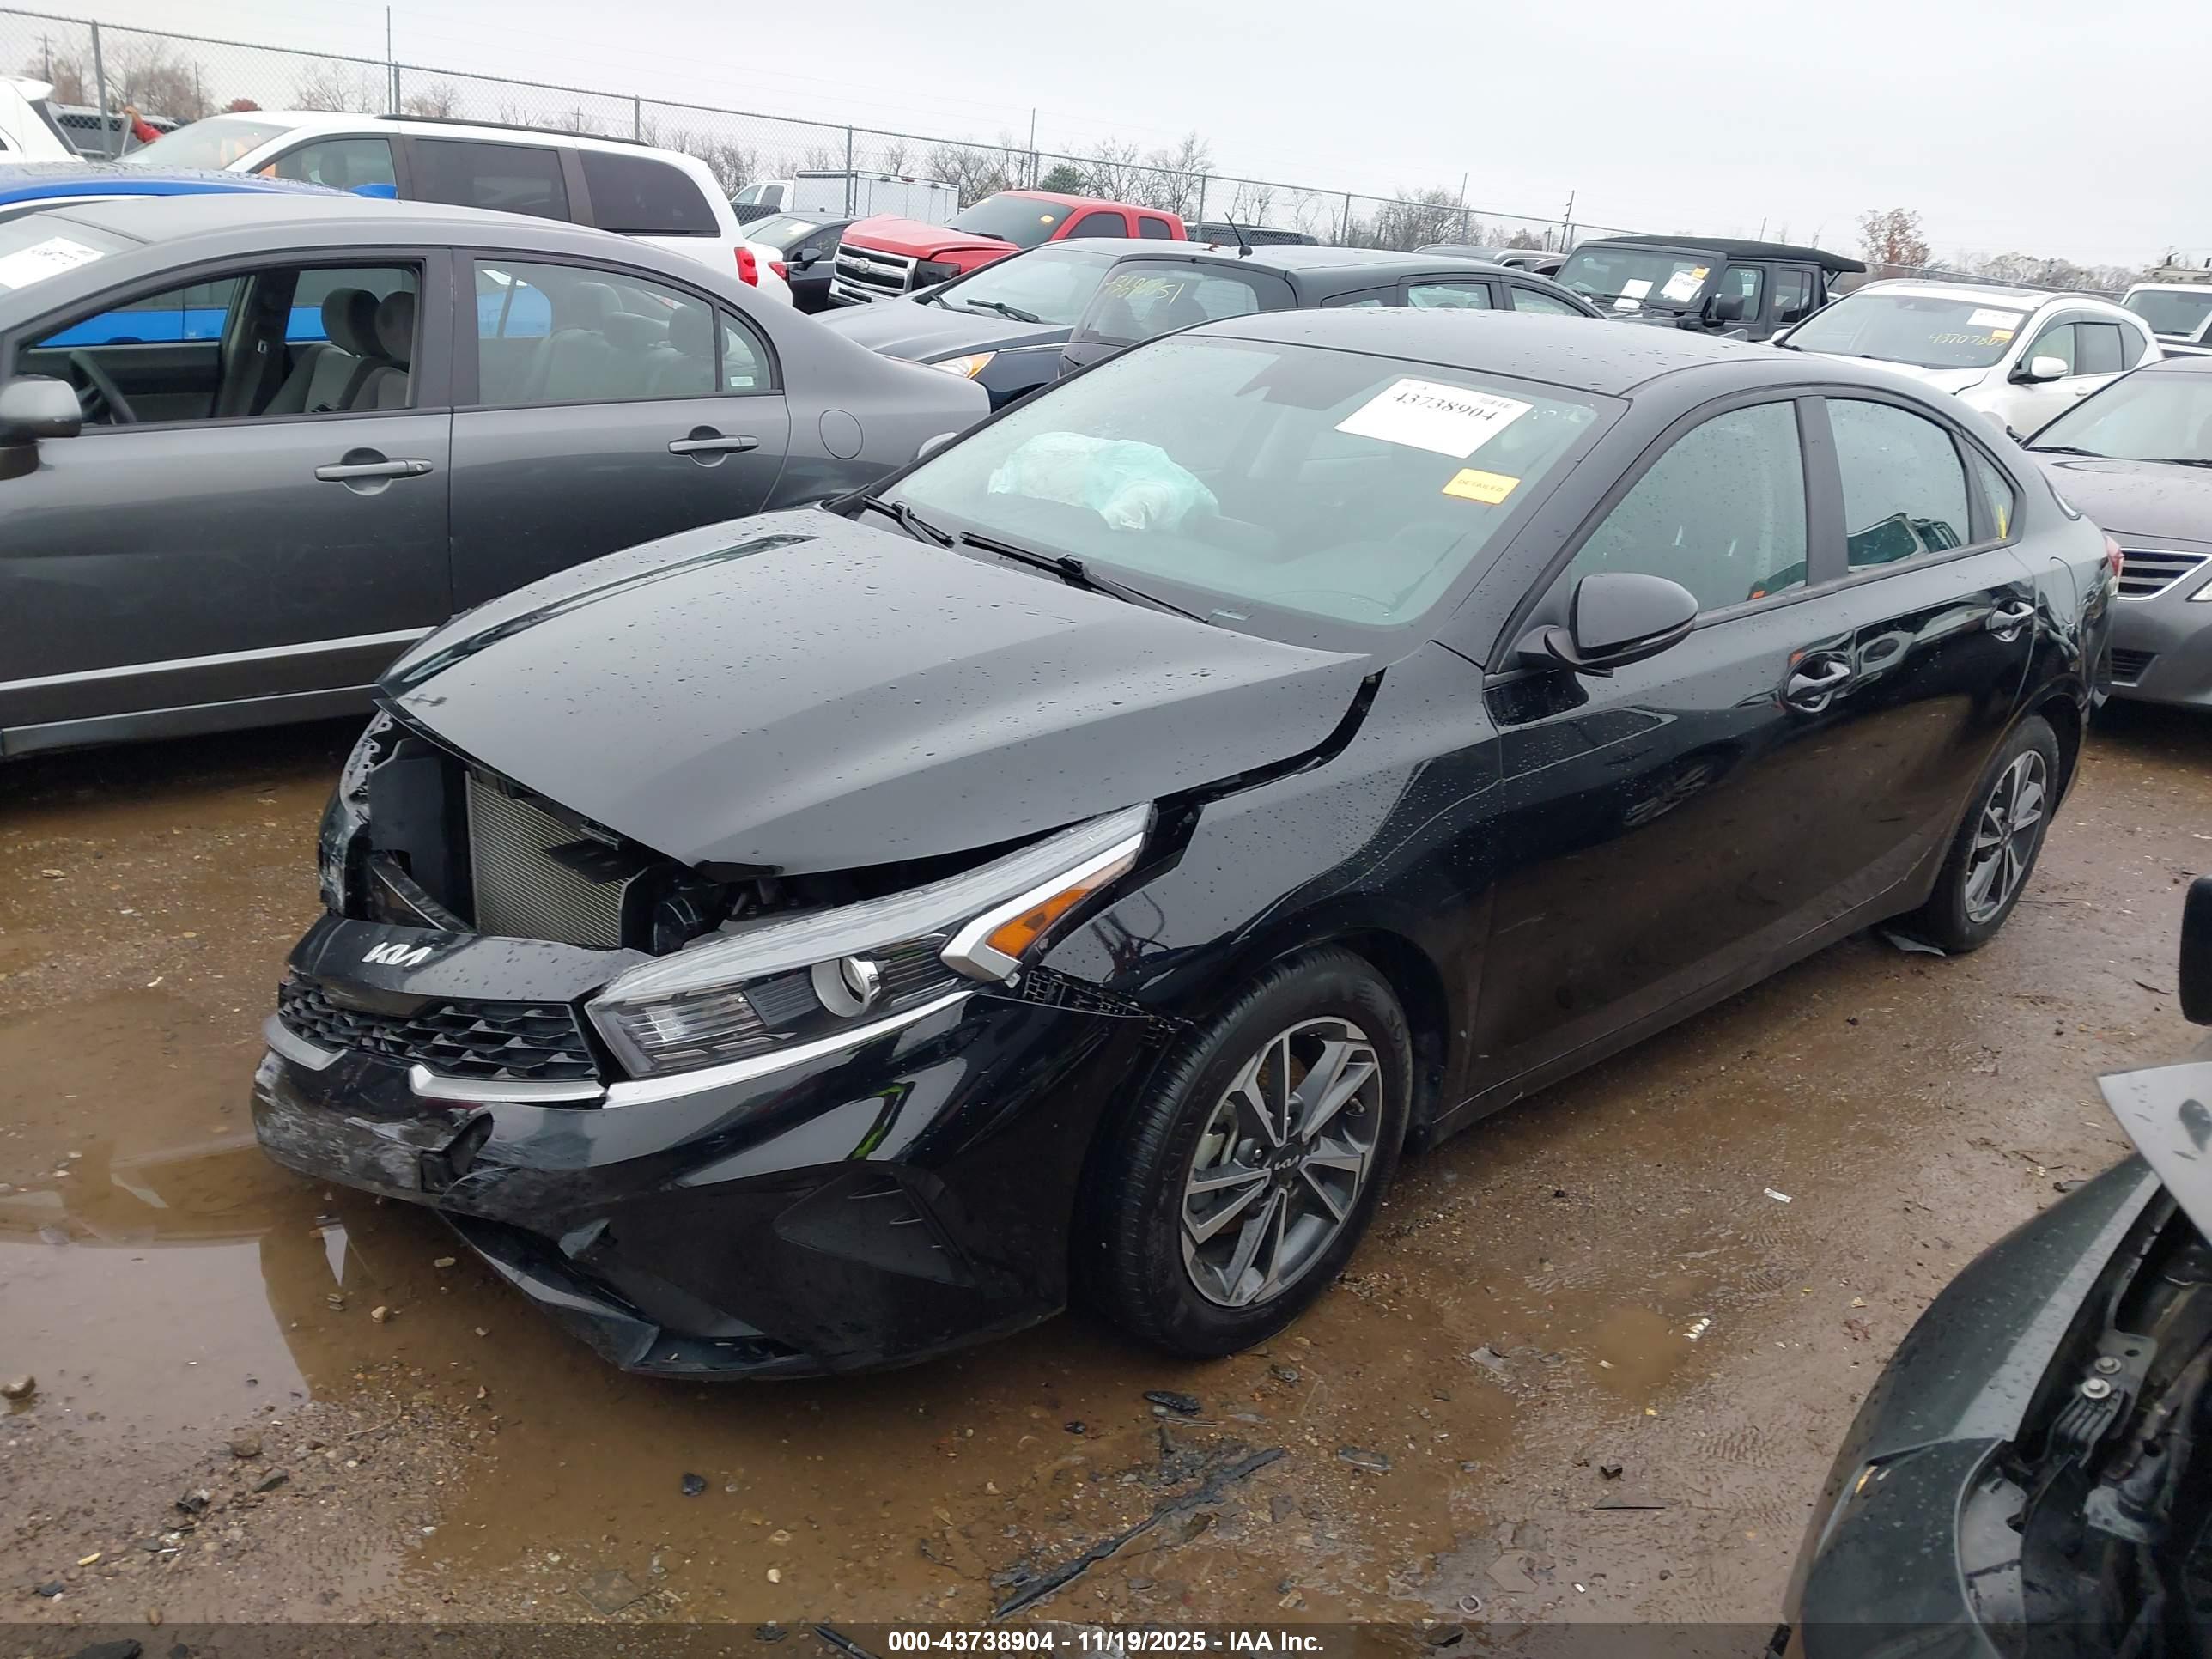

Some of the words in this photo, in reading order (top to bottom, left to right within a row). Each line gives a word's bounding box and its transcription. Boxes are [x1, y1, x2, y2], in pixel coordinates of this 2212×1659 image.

[1393, 392, 1498, 421] 43738904
[1458, 479, 1504, 493] DETAILED
[361, 941, 433, 968] KIA
